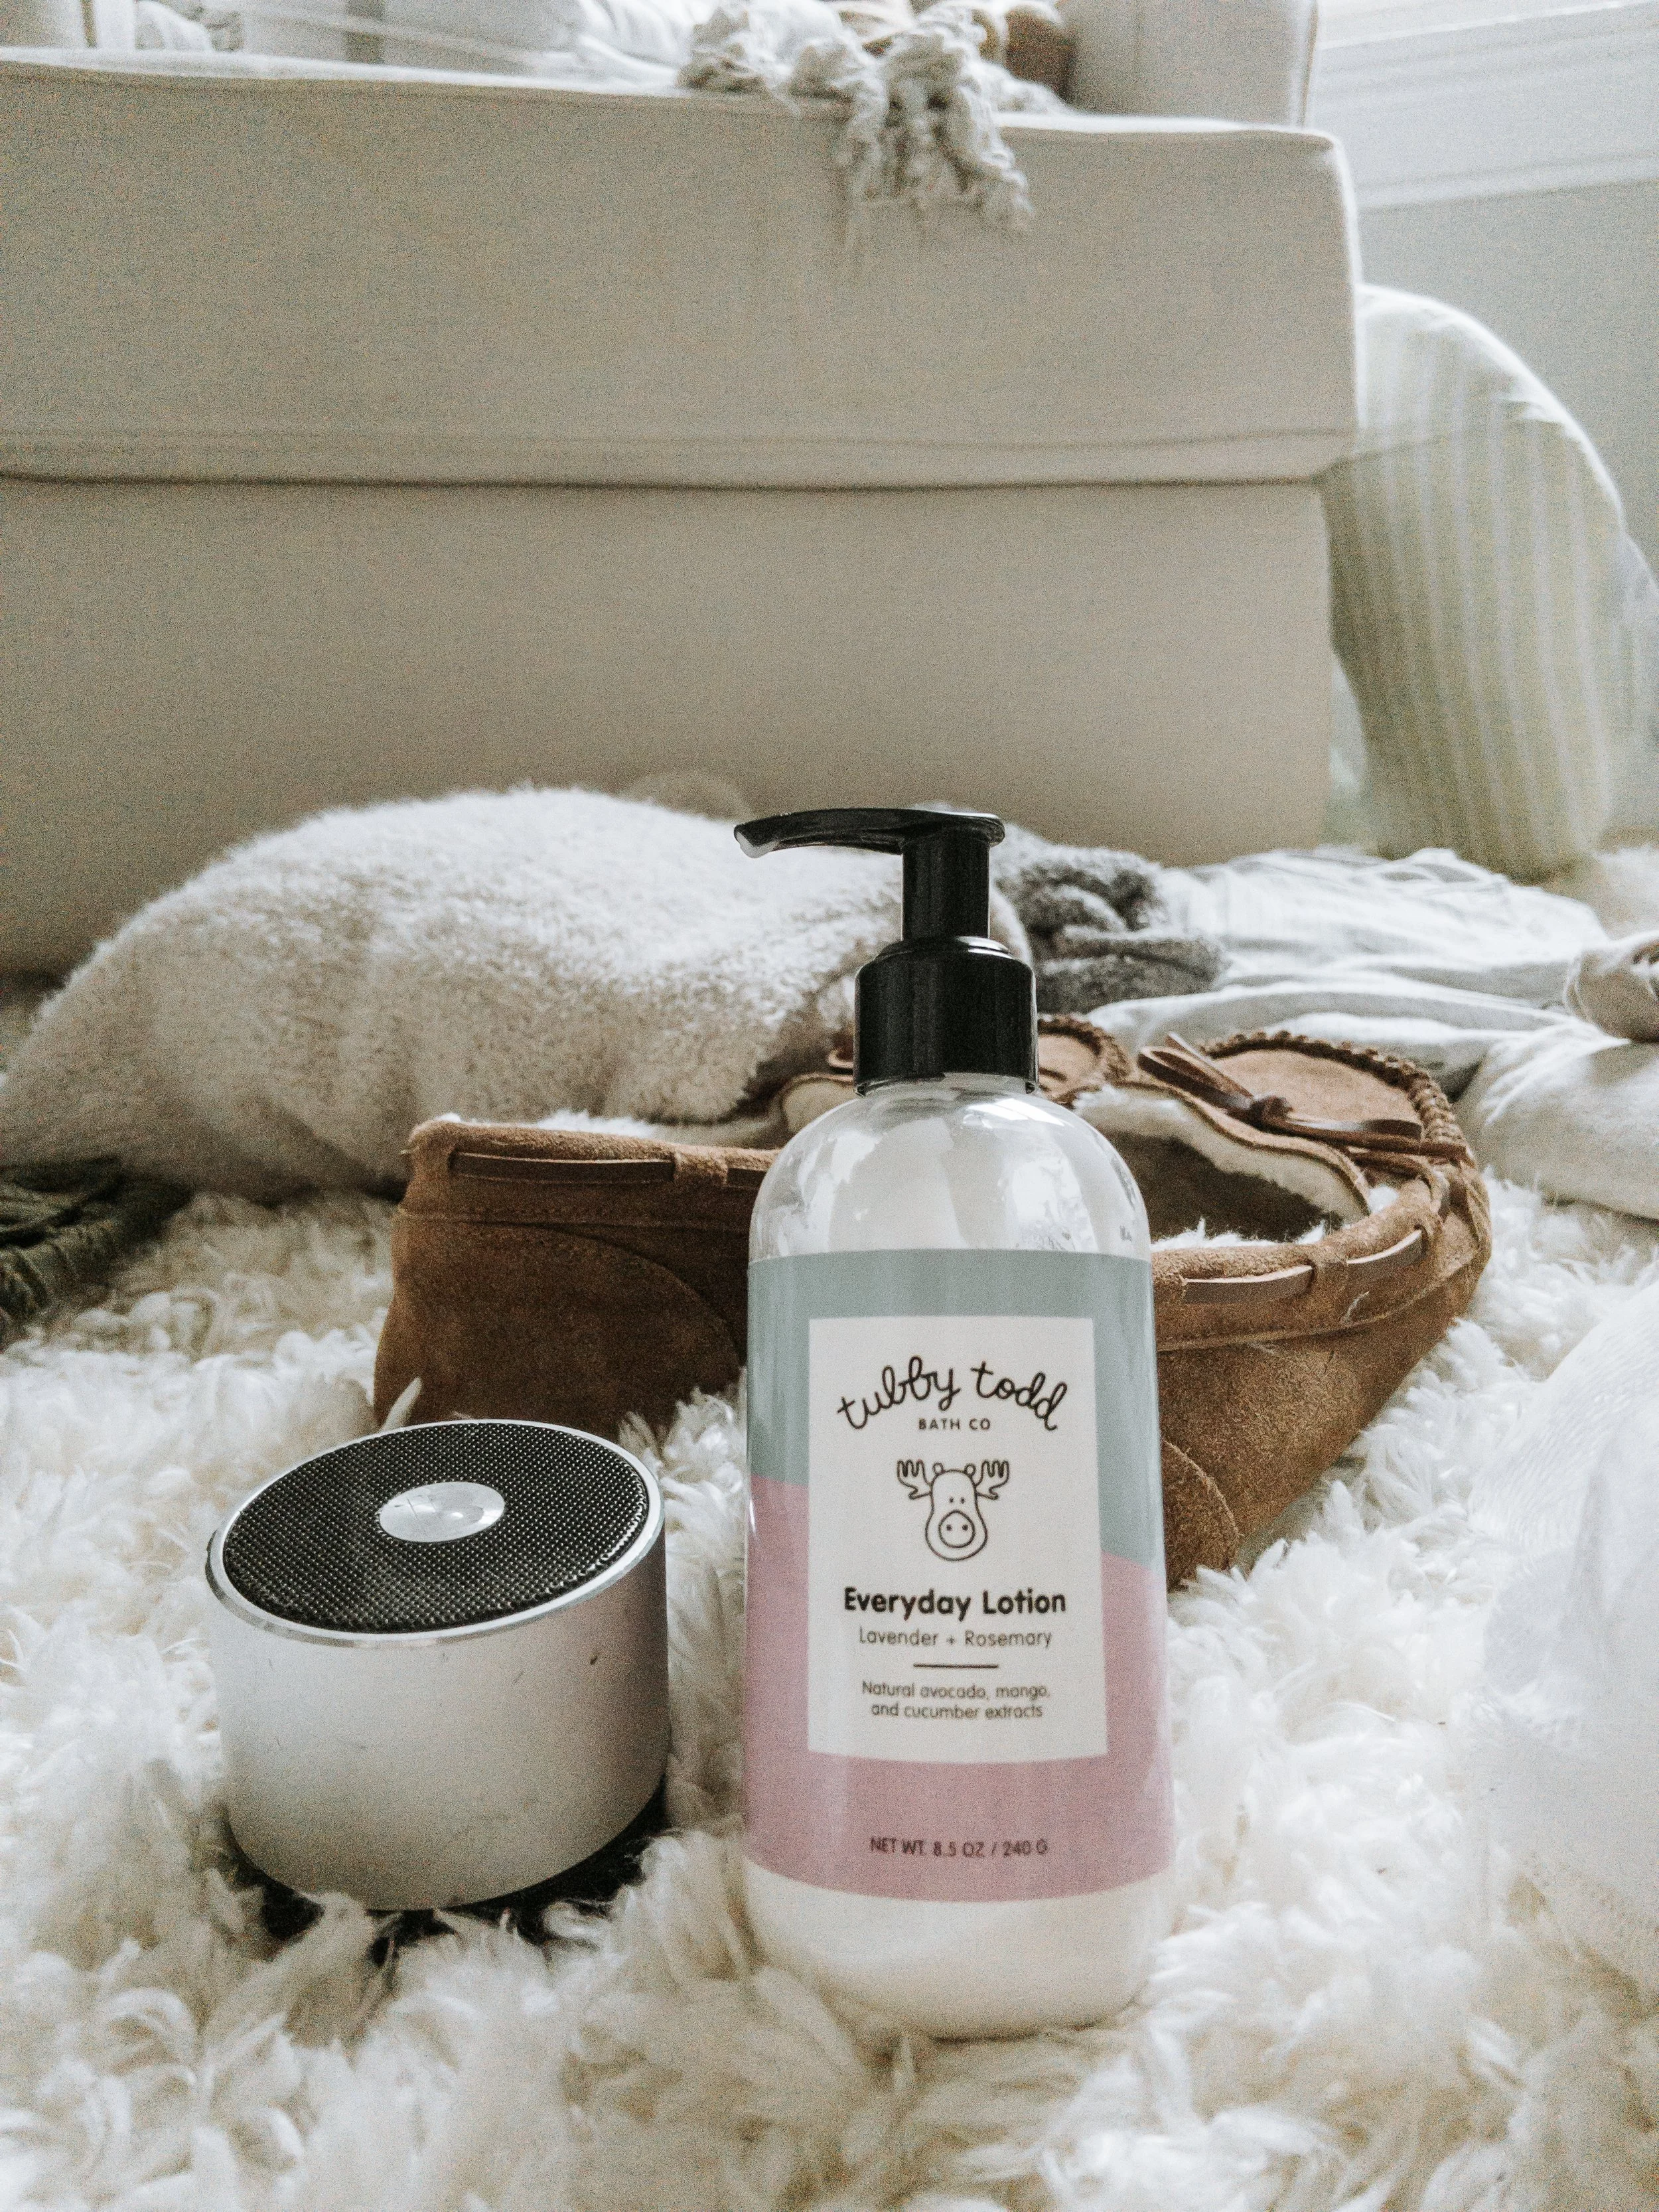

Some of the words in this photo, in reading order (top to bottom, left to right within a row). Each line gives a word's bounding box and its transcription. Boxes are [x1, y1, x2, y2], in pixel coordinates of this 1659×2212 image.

[837, 1356, 960, 1429] tubby
[971, 1361, 1068, 1430] todd
[918, 1418, 960, 1430] BATH
[969, 1418, 991, 1430] CO
[844, 1587, 971, 1621] Everyday
[982, 1587, 1066, 1614] Lotion
[859, 1627, 939, 1646] Lavender
[964, 1630, 1052, 1649] Rosemary
[862, 1682, 915, 1697] Natural
[920, 1684, 989, 1700] avocado,
[871, 1703, 899, 1716] and
[904, 1704, 979, 1719] cucumber
[985, 1706, 1043, 1720] extracts
[870, 1838, 898, 1854] NET
[963, 1840, 984, 1856] OZ
[1004, 1840, 1033, 1856] 240
[1037, 1838, 1048, 1854] G
